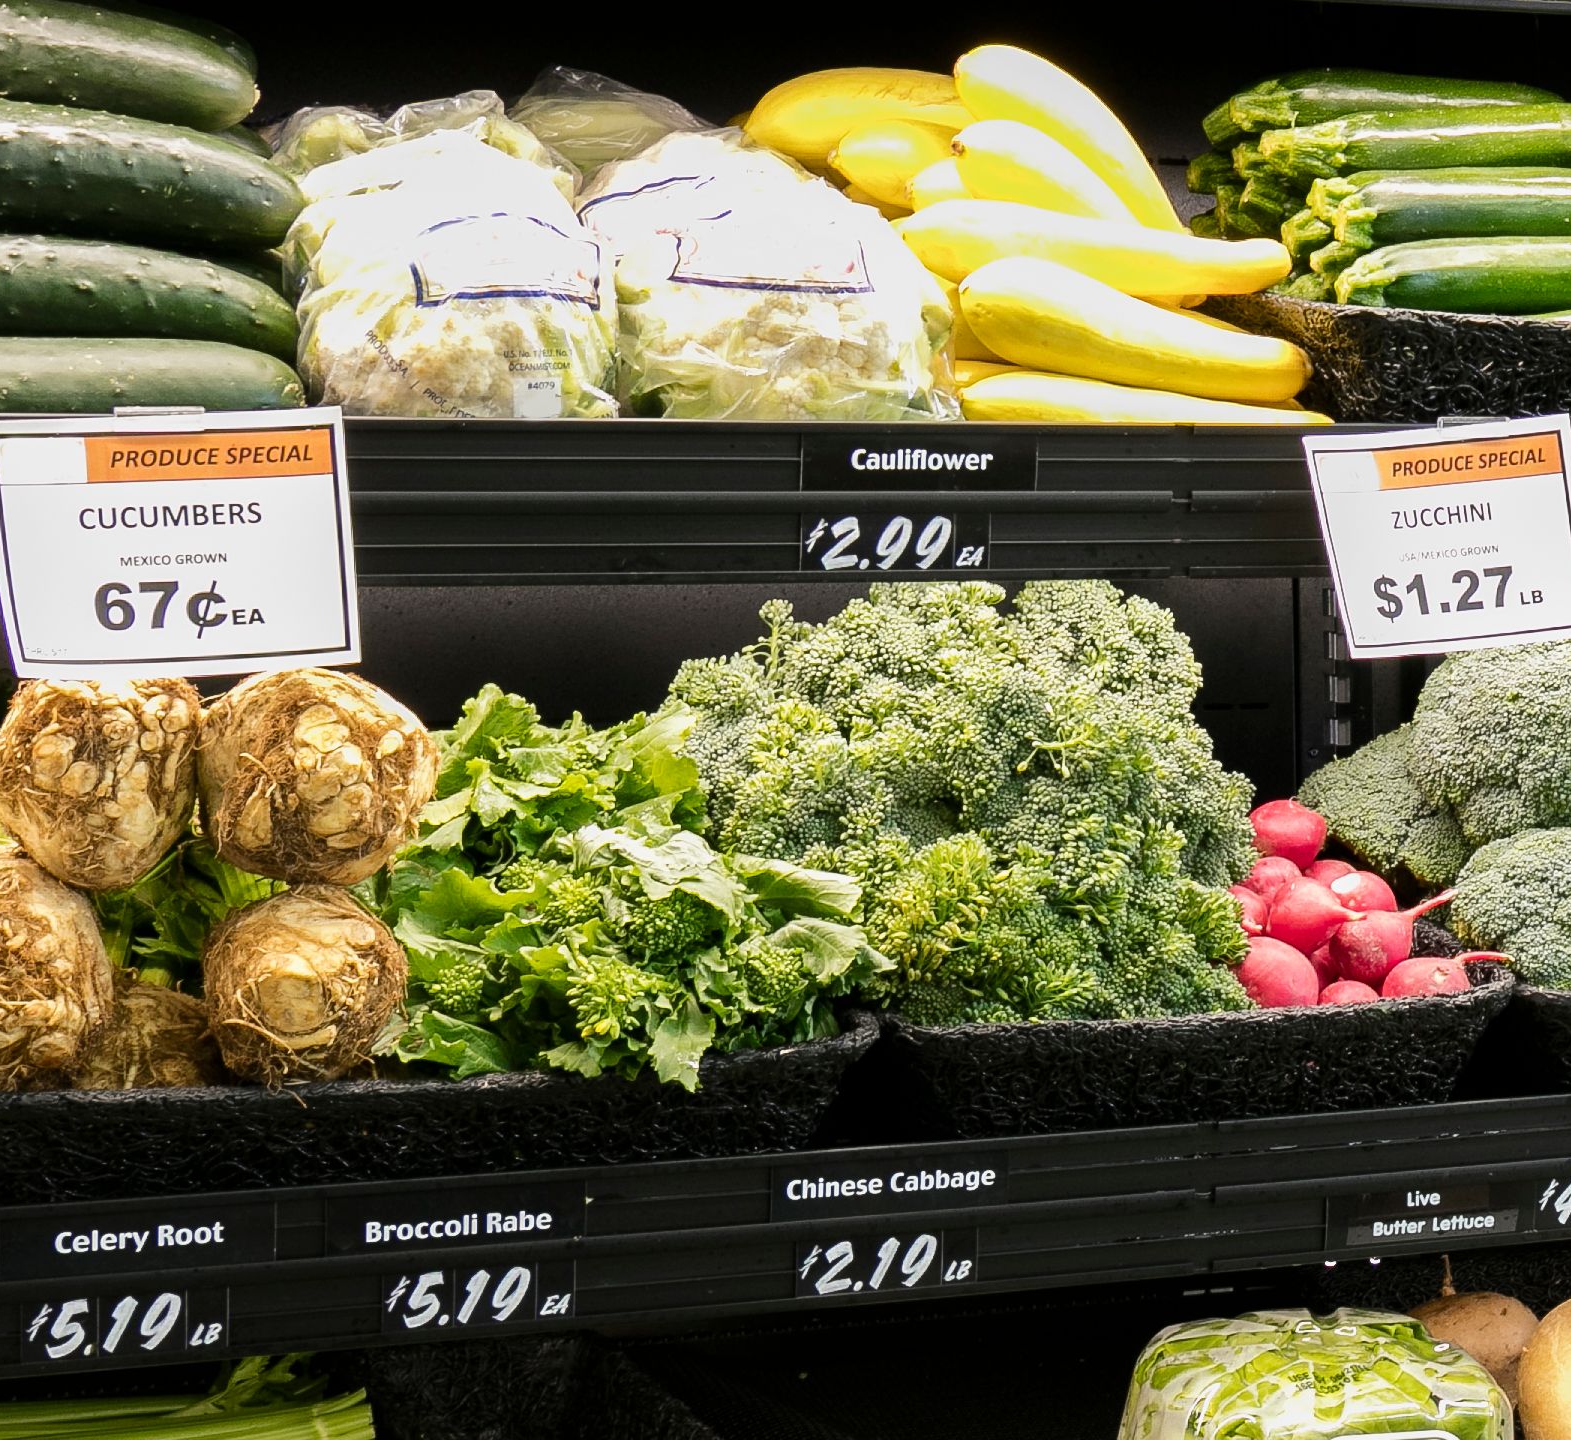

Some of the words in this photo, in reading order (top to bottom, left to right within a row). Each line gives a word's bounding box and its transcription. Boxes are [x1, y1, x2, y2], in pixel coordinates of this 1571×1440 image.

[110, 448, 218, 468] PRODUCE
[228, 444, 313, 464] SPECIAL
[851, 448, 993, 471] Cauliflower
[1392, 454, 1474, 479] PRODUCE
[1479, 447, 1546, 470] SPECIAL
[79, 503, 262, 529] CUCUMBERS
[1391, 502, 1492, 529] ZUCCHINI
[806, 516, 951, 570] $2.99
[956, 546, 983, 567] EA
[120, 554, 171, 566] MEXICO
[175, 553, 227, 565] GROWN
[786, 1175, 883, 1201] Chinese
[890, 1167, 996, 1193] Cabbage
[1407, 1189, 1441, 1208] Live
[365, 1214, 481, 1242] Broccoli
[485, 1210, 553, 1236] Rabe
[1372, 1216, 1427, 1238] Butter
[1432, 1212, 1495, 1234] Lettuce
[54, 1225, 151, 1256] Celery
[158, 1222, 224, 1248] Root
[385, 1266, 530, 1328] $5.19
[539, 1294, 569, 1317] EA
